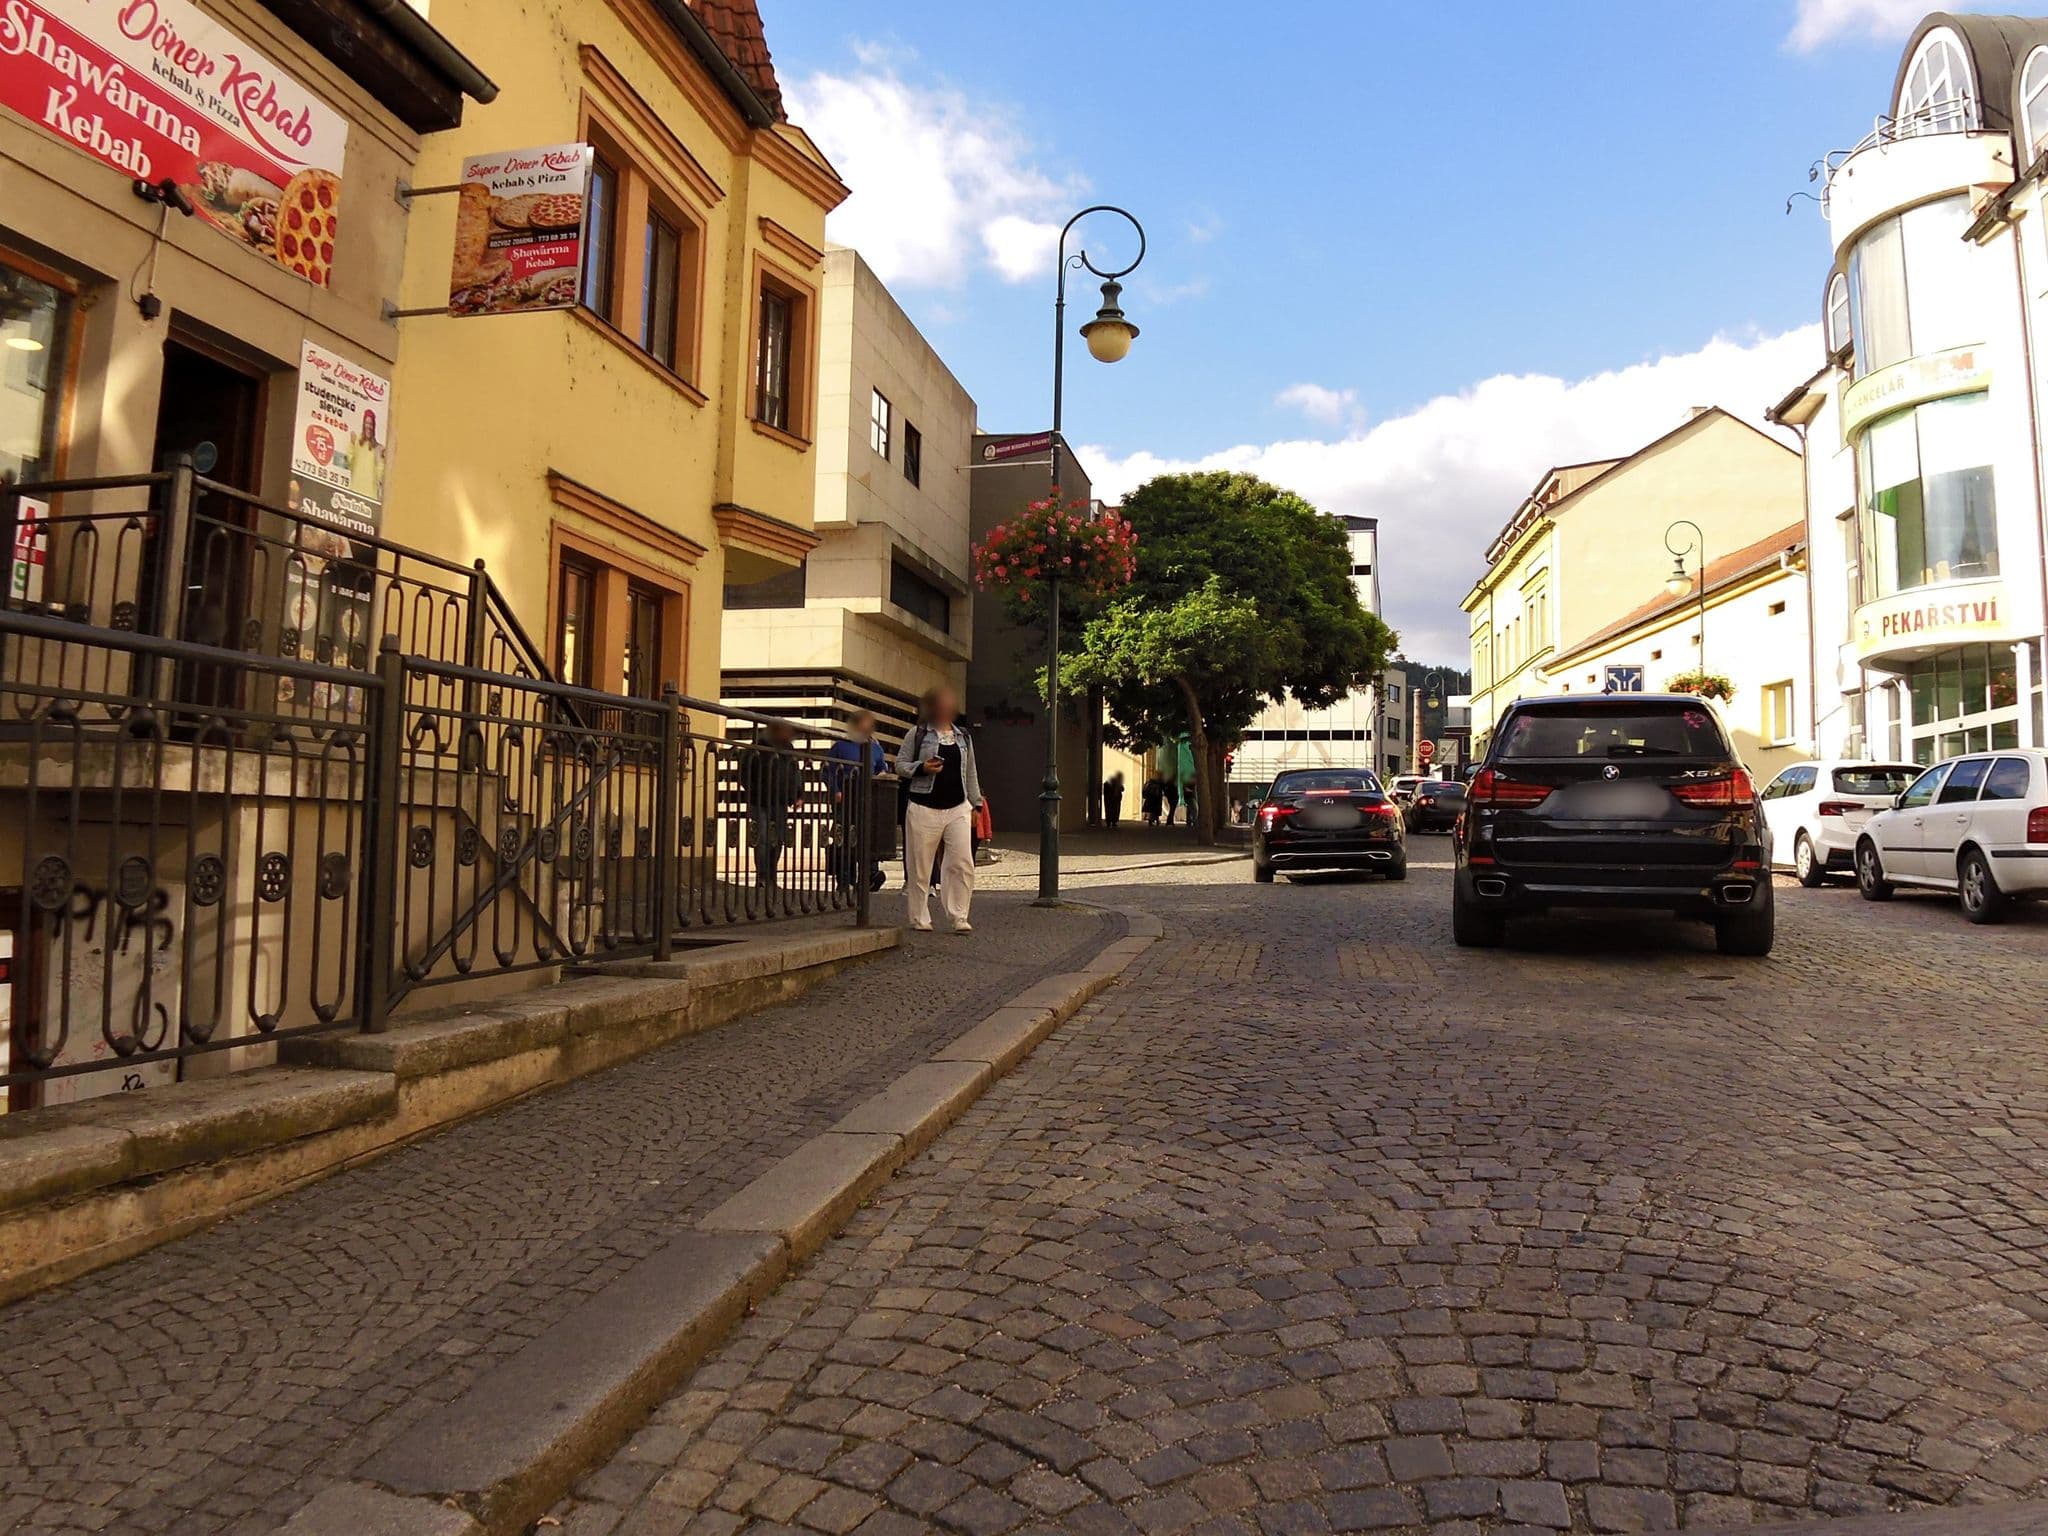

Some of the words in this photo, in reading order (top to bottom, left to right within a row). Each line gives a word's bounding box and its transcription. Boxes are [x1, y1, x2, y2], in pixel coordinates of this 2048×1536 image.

[0, 0, 200, 157] Shawarma
[117, 0, 215, 79] Döner
[219, 54, 313, 165] Kebab
[152, 57, 194, 96] Kebab
[195, 87, 205, 107] &
[208, 95, 241, 128] Pizza
[42, 85, 151, 178] Kebab
[467, 163, 500, 178] Super
[541, 149, 580, 171] Kebab
[492, 177, 525, 190] Kebab
[527, 176, 535, 187] &
[538, 173, 567, 184] Pizza
[511, 245, 570, 261] Shawarma
[526, 256, 556, 268] Kebab
[306, 350, 331, 369] Super
[359, 374, 385, 401] Kebab
[311, 409, 322, 421] na
[324, 414, 349, 432] kebab
[320, 399, 343, 417] sleva
[302, 460, 316, 475] 773
[301, 497, 375, 536] Shawarma
[1883, 596, 1997, 637] PEKAŘSTVÍ
[1681, 770, 1709, 778] X5
